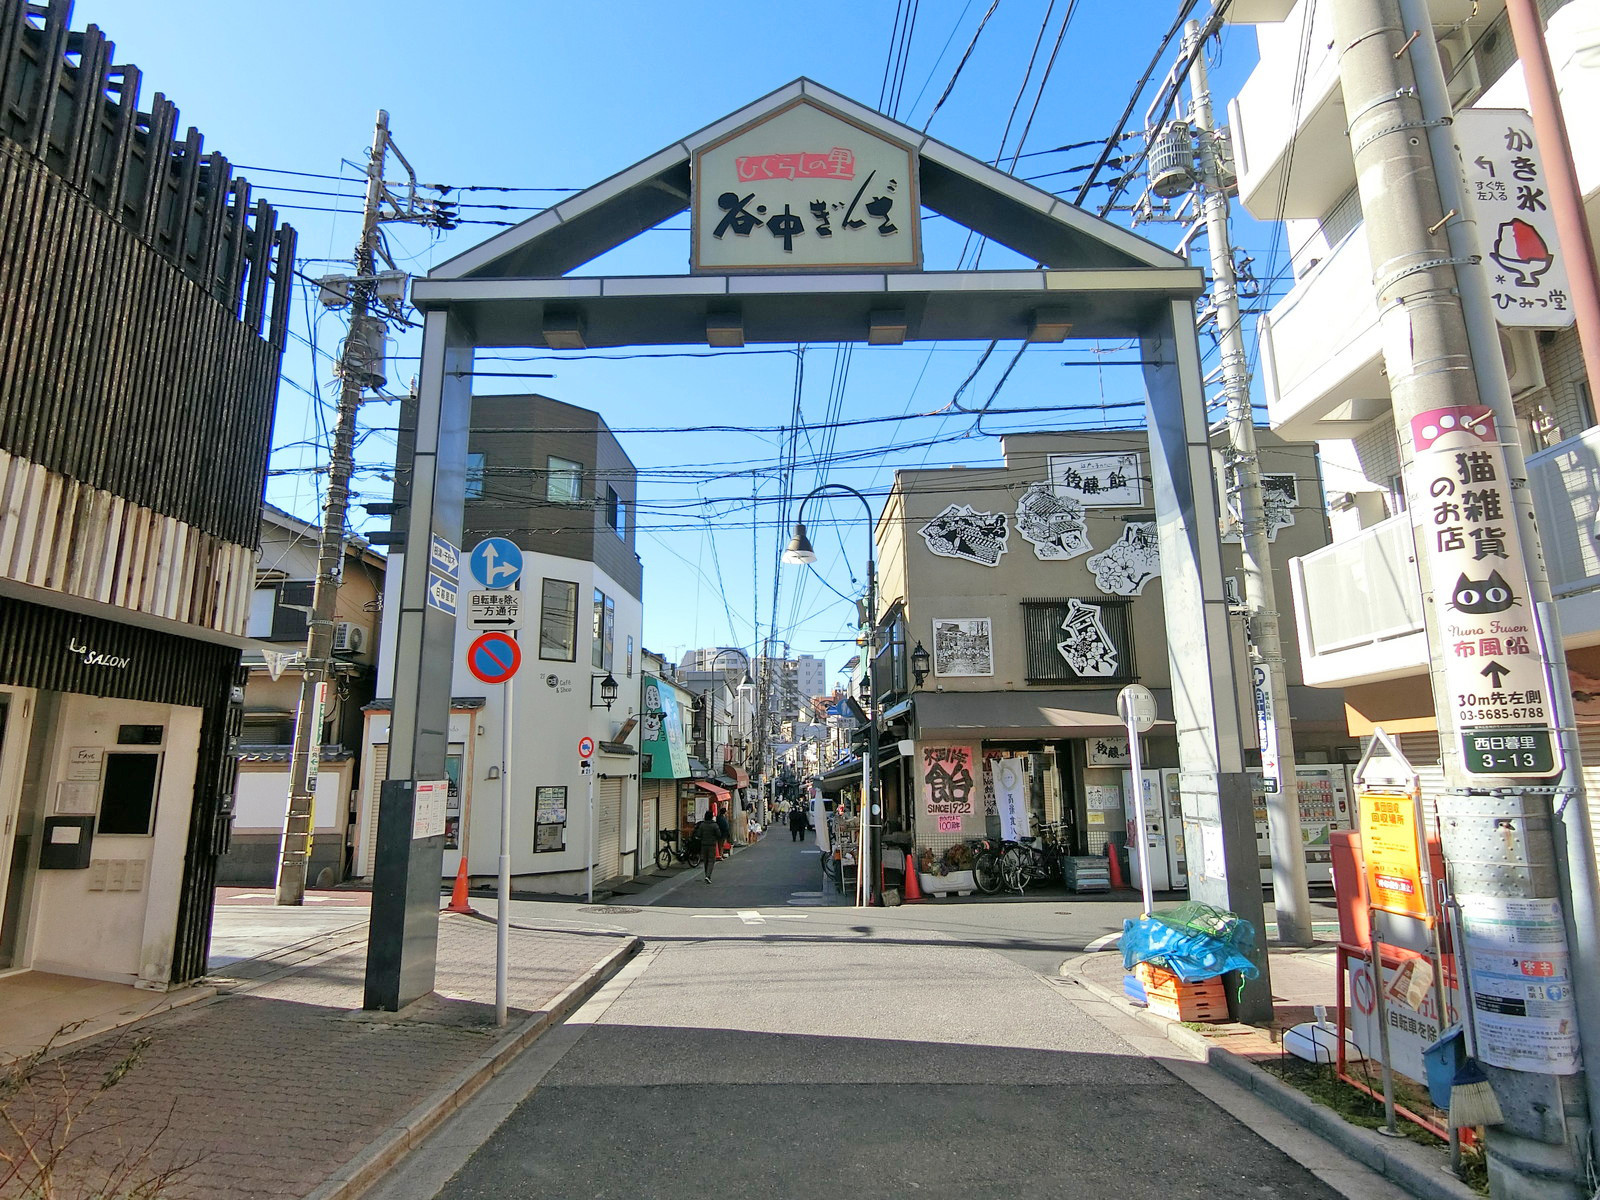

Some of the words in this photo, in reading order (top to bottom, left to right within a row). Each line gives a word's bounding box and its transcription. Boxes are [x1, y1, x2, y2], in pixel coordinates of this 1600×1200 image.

[737, 147, 856, 181] ひぐらしの里
[1503, 126, 1547, 213] かき氷
[1475, 180, 1506, 191] すぐ先
[1477, 191, 1508, 201] 左入る
[712, 169, 899, 254] 谷中ぎんざ
[1491, 289, 1567, 311] ひみつ堂
[1063, 466, 1127, 495] 後藤の飴
[1430, 476, 1466, 553] のお店
[1455, 450, 1510, 561] 猫雑貨
[472, 594, 518, 605] 自転車を除く
[472, 606, 518, 616] 一方通行
[1447, 625, 1485, 637] Nuno
[1490, 620, 1529, 634] Fusen
[1453, 635, 1530, 658] 布風船
[83, 650, 130, 669] SALON
[1458, 689, 1542, 707] 30m先左側
[1460, 707, 1544, 720] 03-5685-6788
[1473, 736, 1536, 750] 西日暮里
[1482, 753, 1534, 767] 3-13
[925, 761, 973, 803] 飴
[927, 803, 949, 813] SINCE
[949, 802, 971, 813] 1922
[1371, 812, 1404, 825] 回収場所
